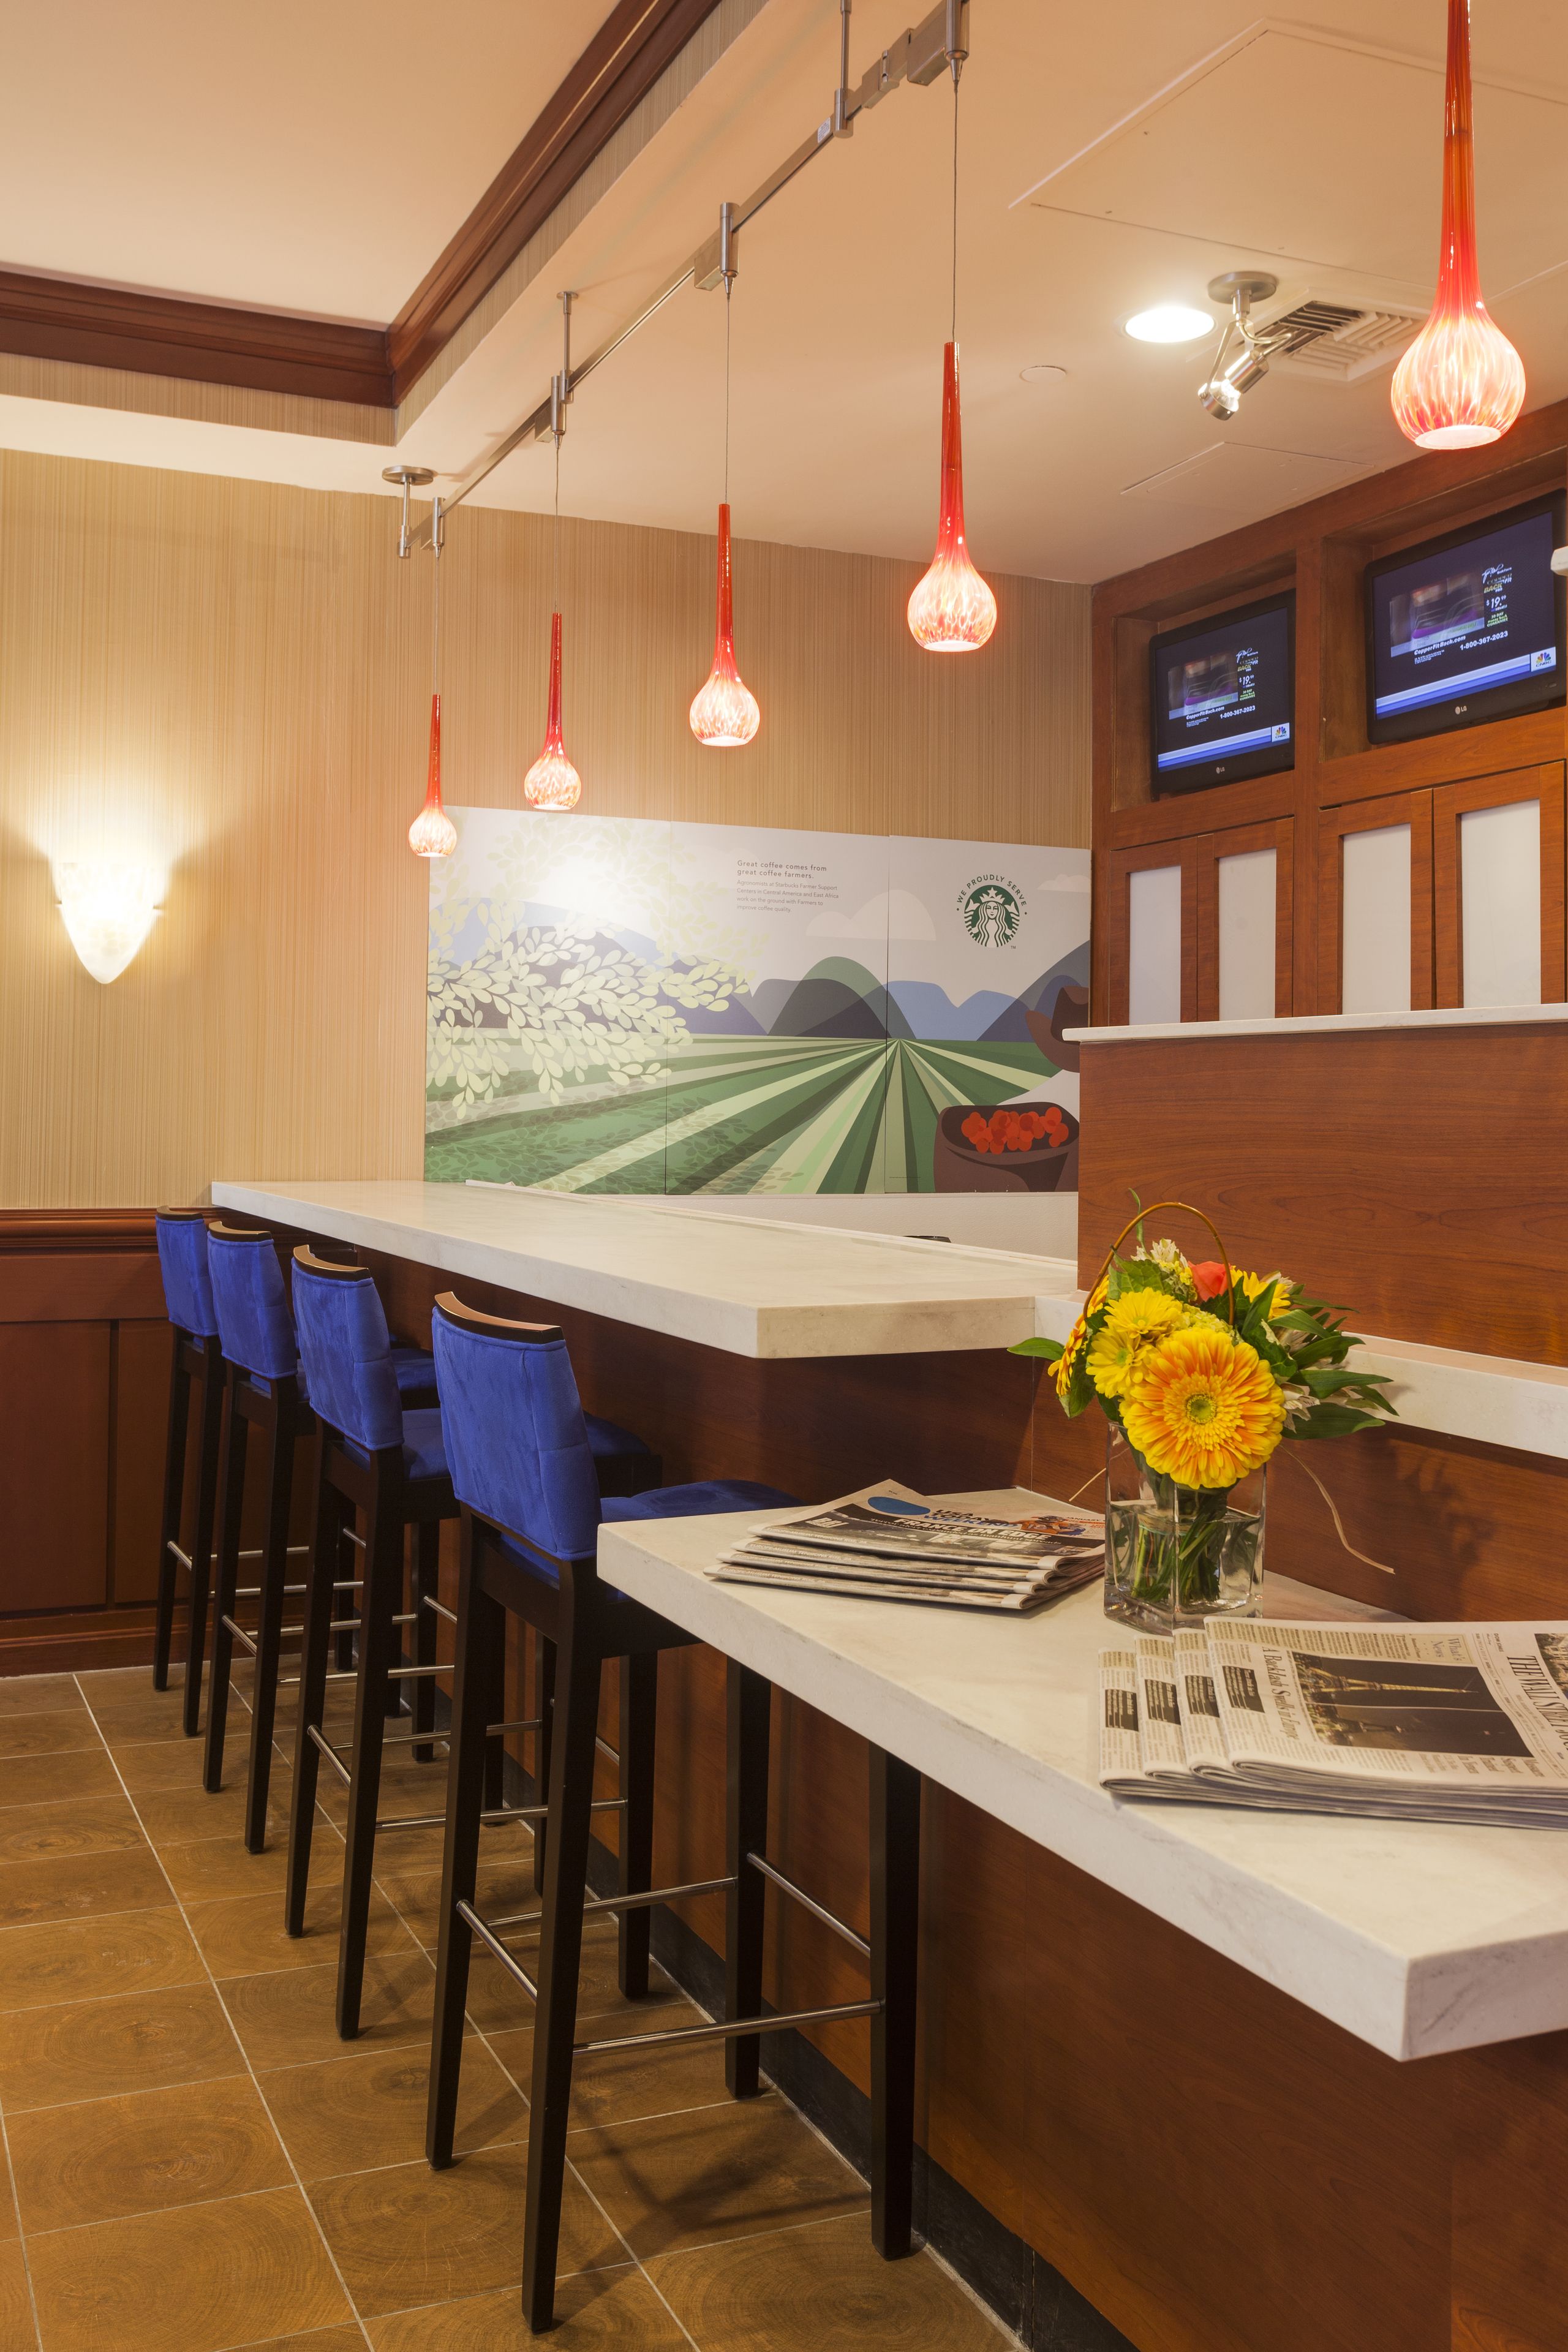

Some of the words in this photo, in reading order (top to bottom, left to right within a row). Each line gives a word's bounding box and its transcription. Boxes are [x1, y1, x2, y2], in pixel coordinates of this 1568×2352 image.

[1484, 582, 1502, 594] BACK
[1414, 635, 1466, 655] CopperFitBack.com
[1460, 630, 1509, 650] 1-800-367-2023
[1220, 706, 1256, 719] 1-800-367-2023
[957, 889, 967, 903] WE
[967, 874, 1005, 889] PROUDLY
[1007, 881, 1027, 907] SERVE
[894, 1518, 967, 1531] FRANCE
[998, 1530, 1052, 1540] EDGE
[1430, 1640, 1445, 1658] News
[1447, 1638, 1466, 1661] What's
[1264, 1654, 1289, 1687] Backlash
[1506, 1655, 1545, 1677] THE
[1272, 1688, 1295, 1710] Swells
[1518, 1679, 1561, 1700] WALL
[1280, 1717, 1300, 1740] Europe
